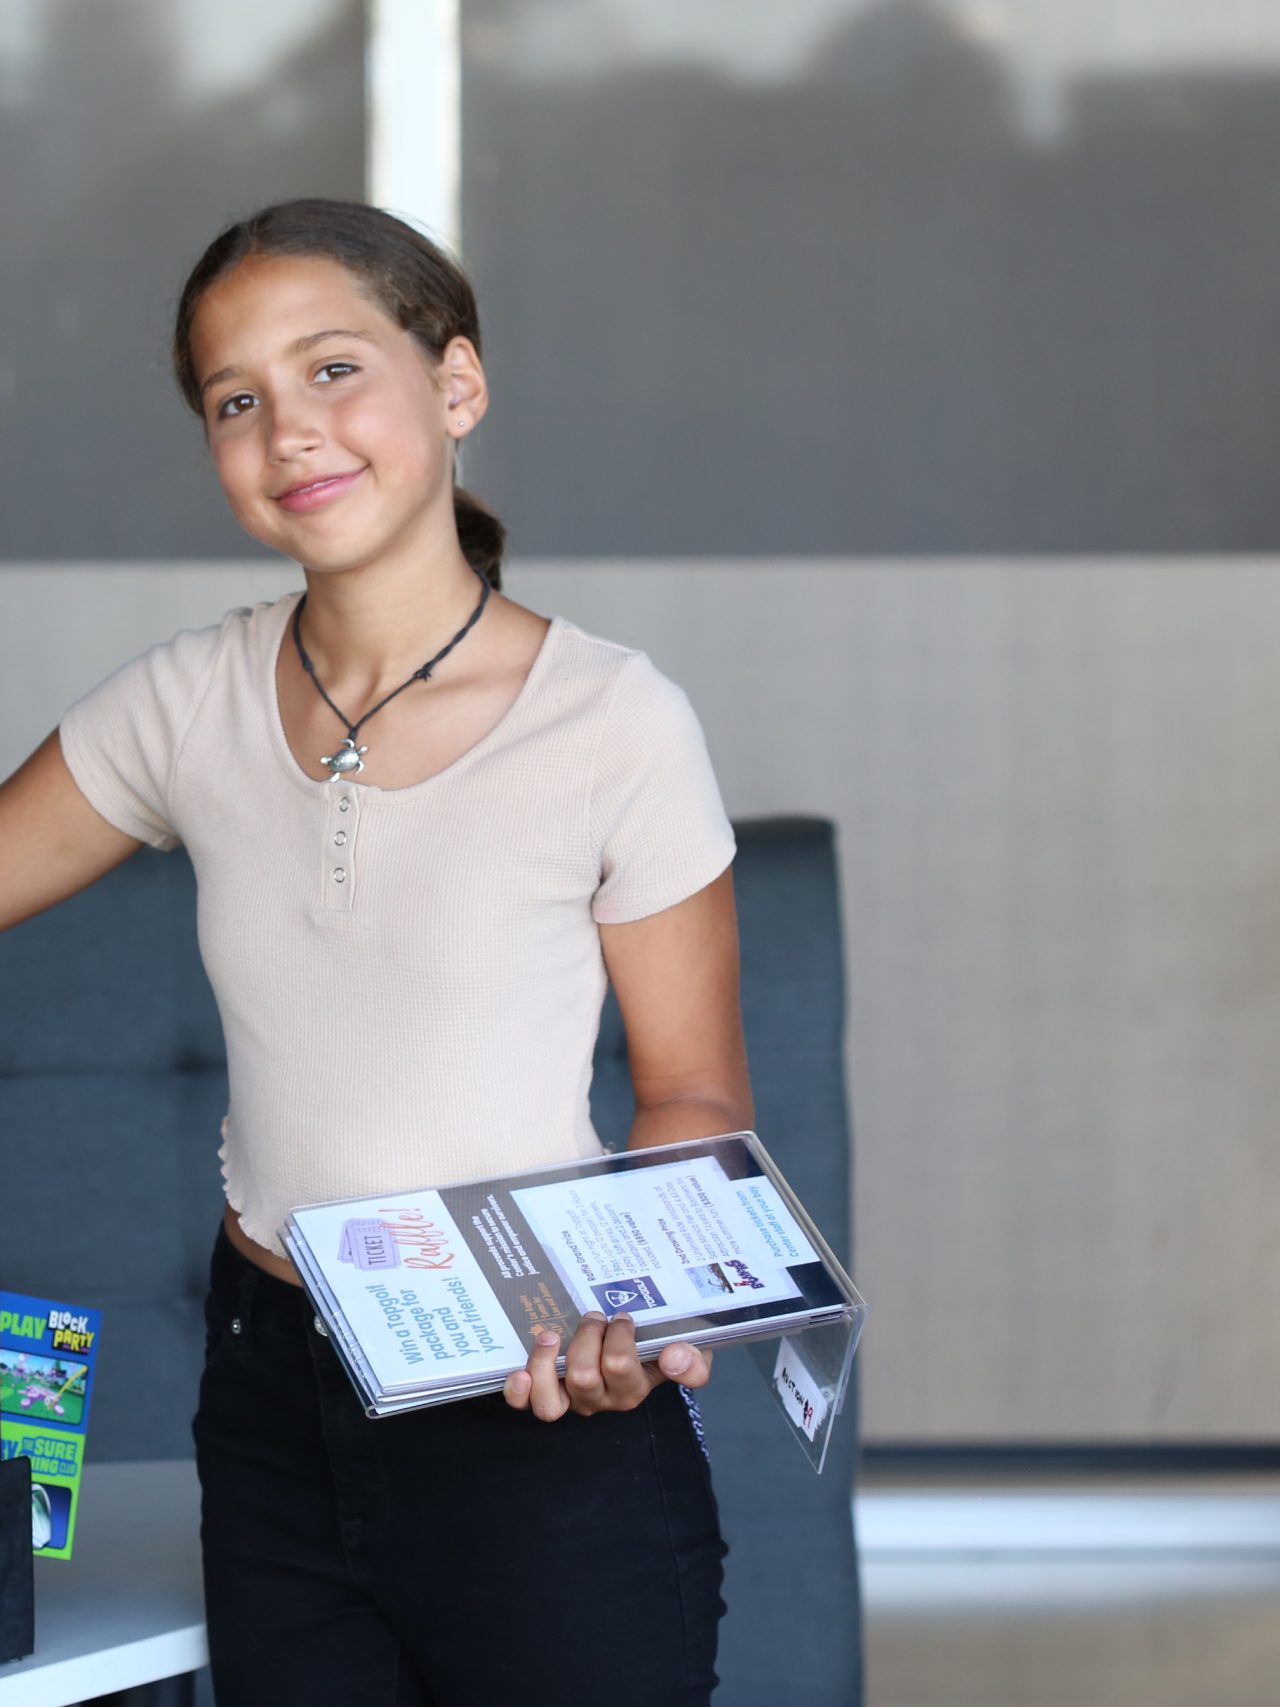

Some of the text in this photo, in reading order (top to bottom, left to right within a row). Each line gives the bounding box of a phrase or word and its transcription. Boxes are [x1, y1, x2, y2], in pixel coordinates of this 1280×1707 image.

[686, 1175, 704, 1192] value)
[748, 1186, 762, 1198] bay
[481, 1208, 496, 1226] secure
[756, 1198, 773, 1213] your
[620, 1211, 638, 1228] value)
[734, 1190, 783, 1257] Purchase tickets from
[768, 1221, 785, 1234] staff
[378, 1208, 454, 1268] Raffle!
[493, 1232, 511, 1253] mission
[500, 1220, 520, 1245] empower
[656, 1218, 690, 1264] 2nd Drawing Prize
[364, 1235, 386, 1265] TICKET
[471, 1215, 512, 1278] All proceeds support the
[513, 1244, 526, 1256] and
[560, 1230, 596, 1281] Raffle Grand Prize
[779, 1235, 799, 1257] Center
[505, 1253, 524, 1276] Center's
[633, 1278, 657, 1308] TOPGOLF
[48, 1310, 89, 1334] BLOCK
[365, 1283, 424, 1364] Win a Topgolf
[398, 1288, 454, 1359] package for
[441, 1277, 503, 1352] your friends!
[53, 1329, 95, 1352] PARTY
[431, 1306, 479, 1356] you and
[34, 1438, 76, 1461] SURE
